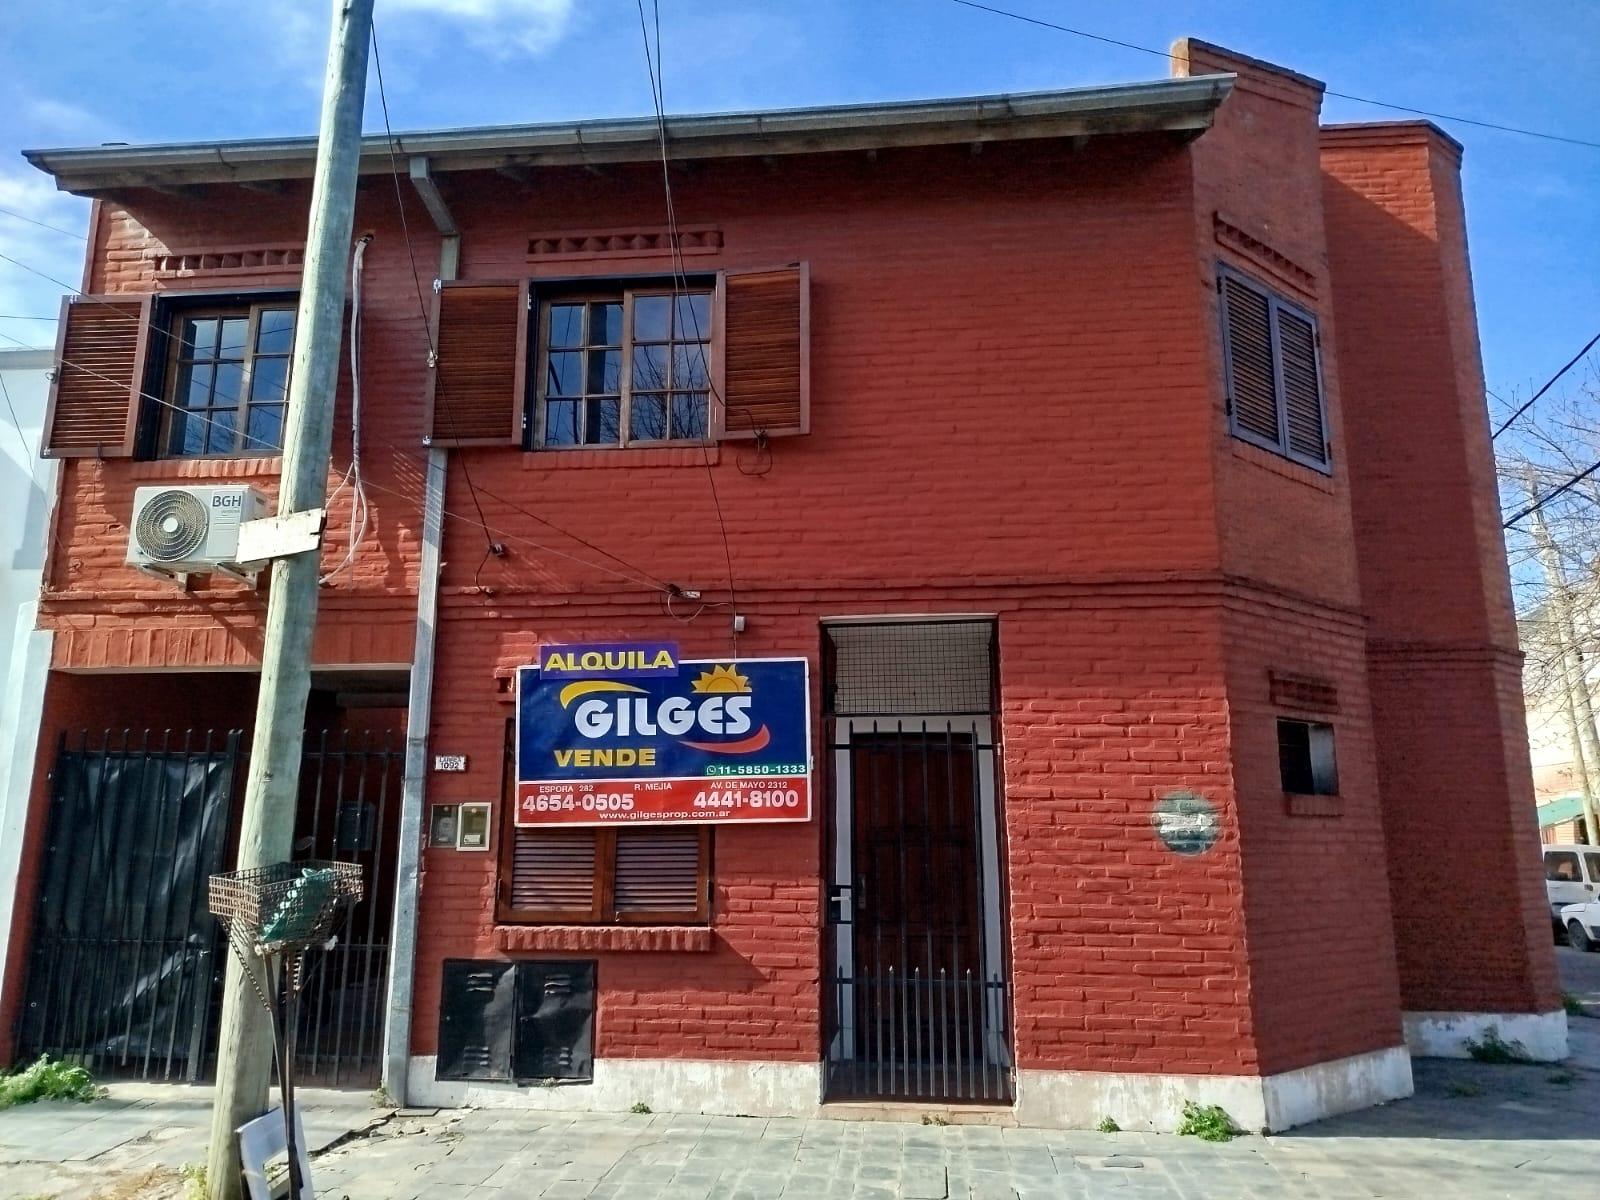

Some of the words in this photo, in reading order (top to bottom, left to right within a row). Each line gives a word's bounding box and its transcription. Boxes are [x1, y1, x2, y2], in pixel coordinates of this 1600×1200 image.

[212, 495, 241, 507] BGH
[544, 650, 676, 671] ALQUILA
[574, 696, 752, 738] GILGES
[554, 748, 657, 767] VENDE
[718, 765, 806, 775] 11-5850-1333
[539, 785, 574, 793] ESPORA
[579, 784, 594, 792] 282
[634, 783, 643, 791] R.
[645, 782, 673, 791] MEJIA
[710, 782, 723, 790] AV.
[725, 781, 737, 789] DE
[739, 781, 766, 789] MAYO
[767, 781, 788, 789] 2312
[522, 793, 635, 812] 4654-0505
[693, 789, 799, 809] 4441-8100
[599, 810, 731, 820] www.gilgesprop.com.ar
